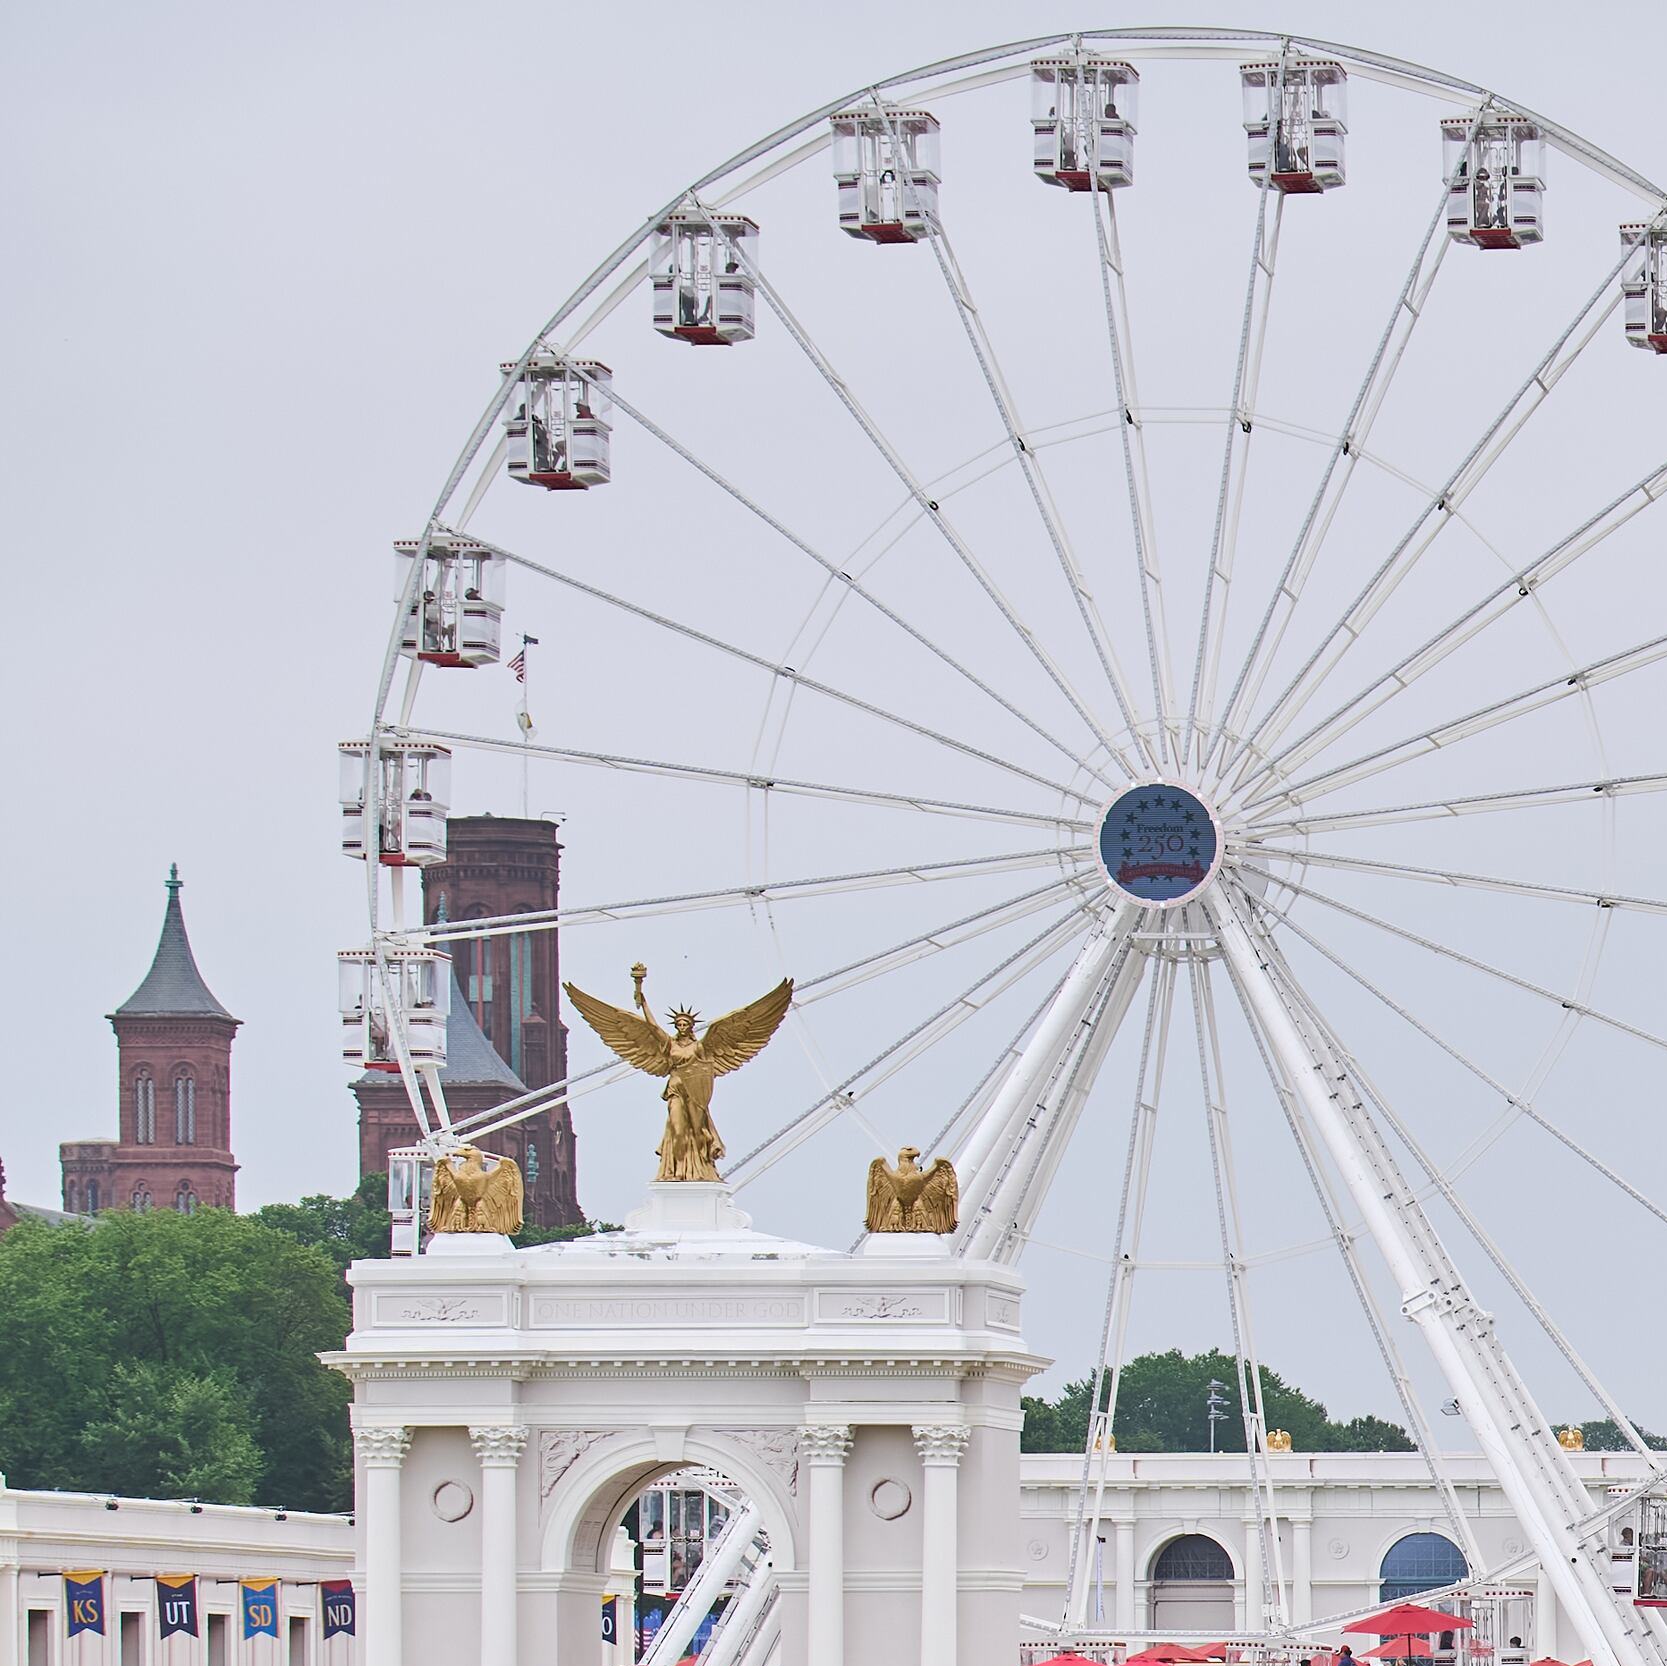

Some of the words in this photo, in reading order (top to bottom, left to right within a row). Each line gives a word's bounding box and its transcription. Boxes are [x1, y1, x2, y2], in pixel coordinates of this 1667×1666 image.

[1137, 822, 1184, 833] Freedom
[1138, 834, 1184, 860] 250
[538, 1302, 588, 1320] ONE
[589, 1302, 668, 1320] NATION
[673, 1302, 746, 1320] UNDER
[752, 1302, 800, 1320] GOD
[73, 1599, 98, 1624] KS
[165, 1601, 190, 1625] UT
[249, 1604, 272, 1628] SD
[327, 1604, 353, 1627] ND
